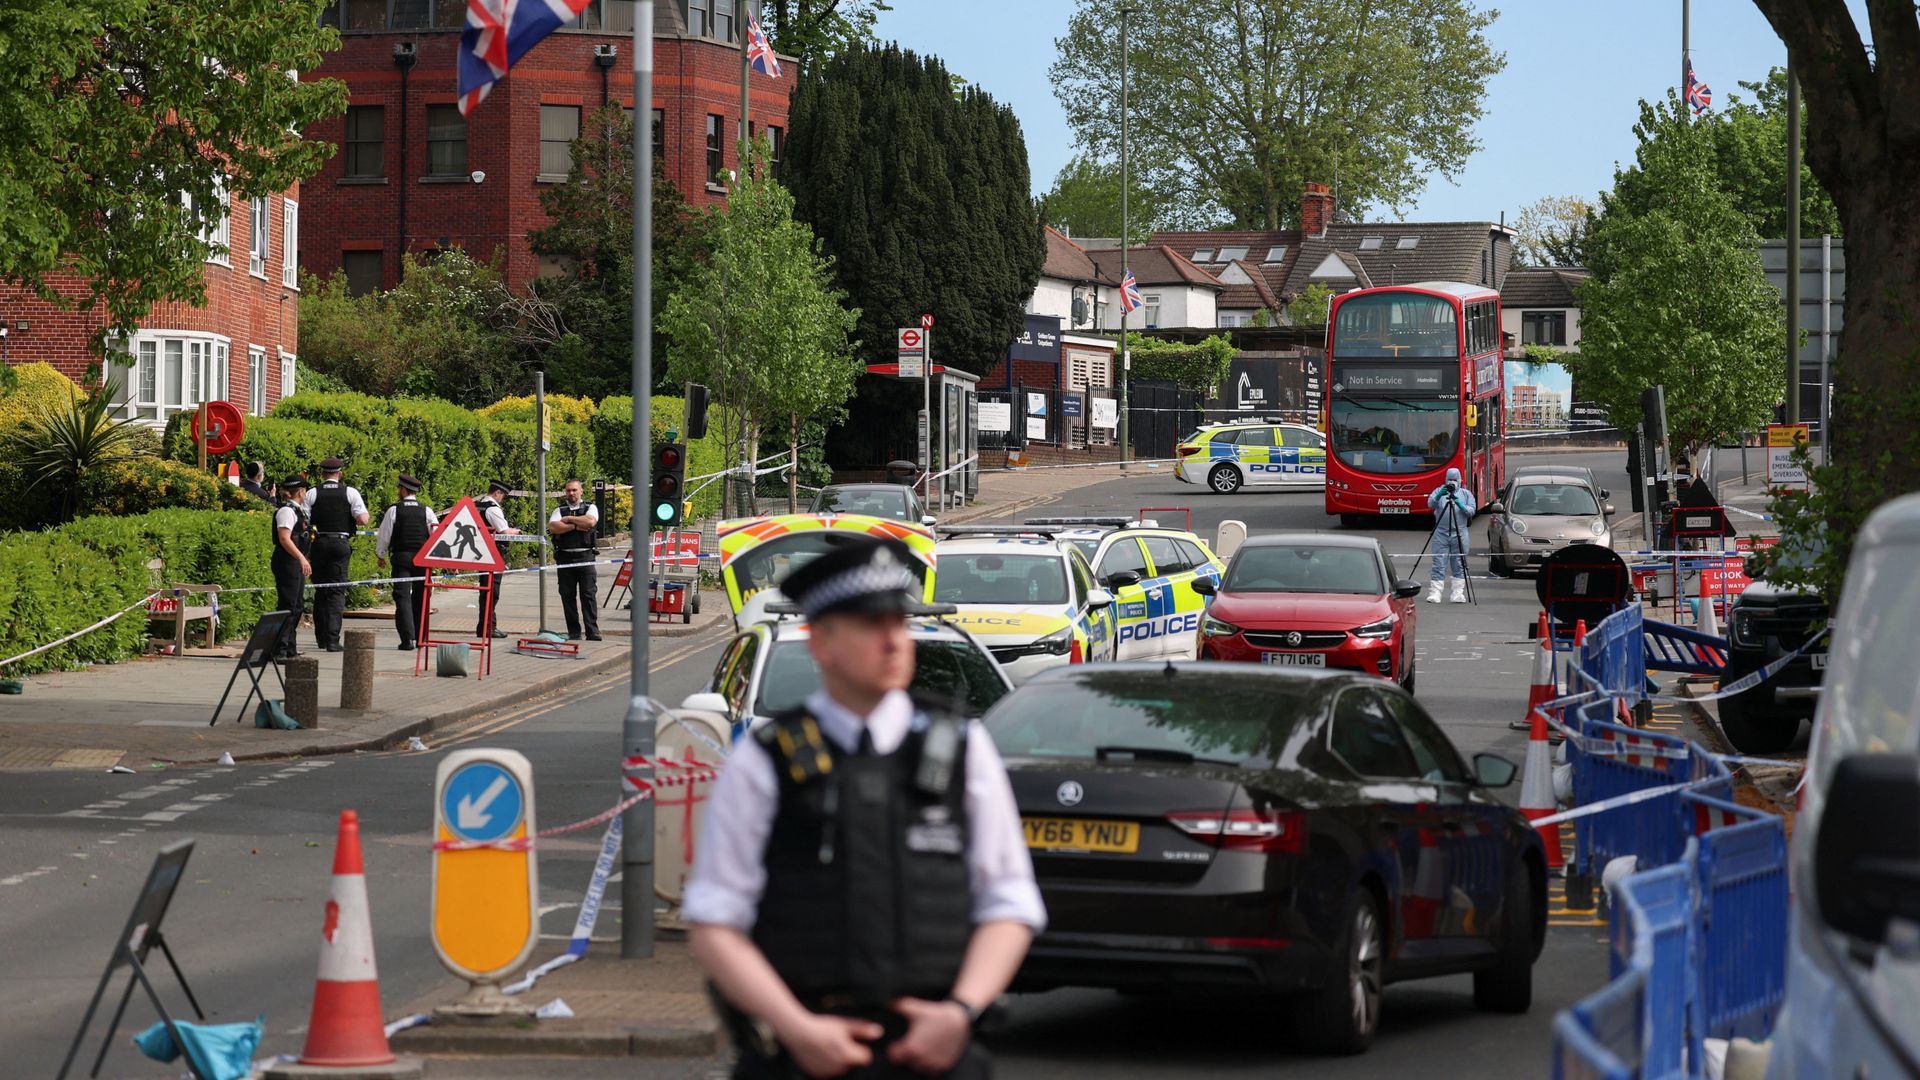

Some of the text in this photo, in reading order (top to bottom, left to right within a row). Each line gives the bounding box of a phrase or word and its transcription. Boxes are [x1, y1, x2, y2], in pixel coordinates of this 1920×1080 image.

[922, 316, 932, 326] N
[1349, 376, 1402, 385] Not in Service
[1249, 464, 1326, 474] POLICE
[1378, 498, 1411, 506] Metroline
[1713, 571, 1742, 580] LOOK
[1119, 613, 1197, 644] POLICE
[1271, 653, 1321, 665] FT71 GWG
[1082, 823, 1128, 847] YNU
[579, 893, 598, 929] POLICE
[589, 872, 607, 894] LINE
[603, 836, 618, 855] NOT
